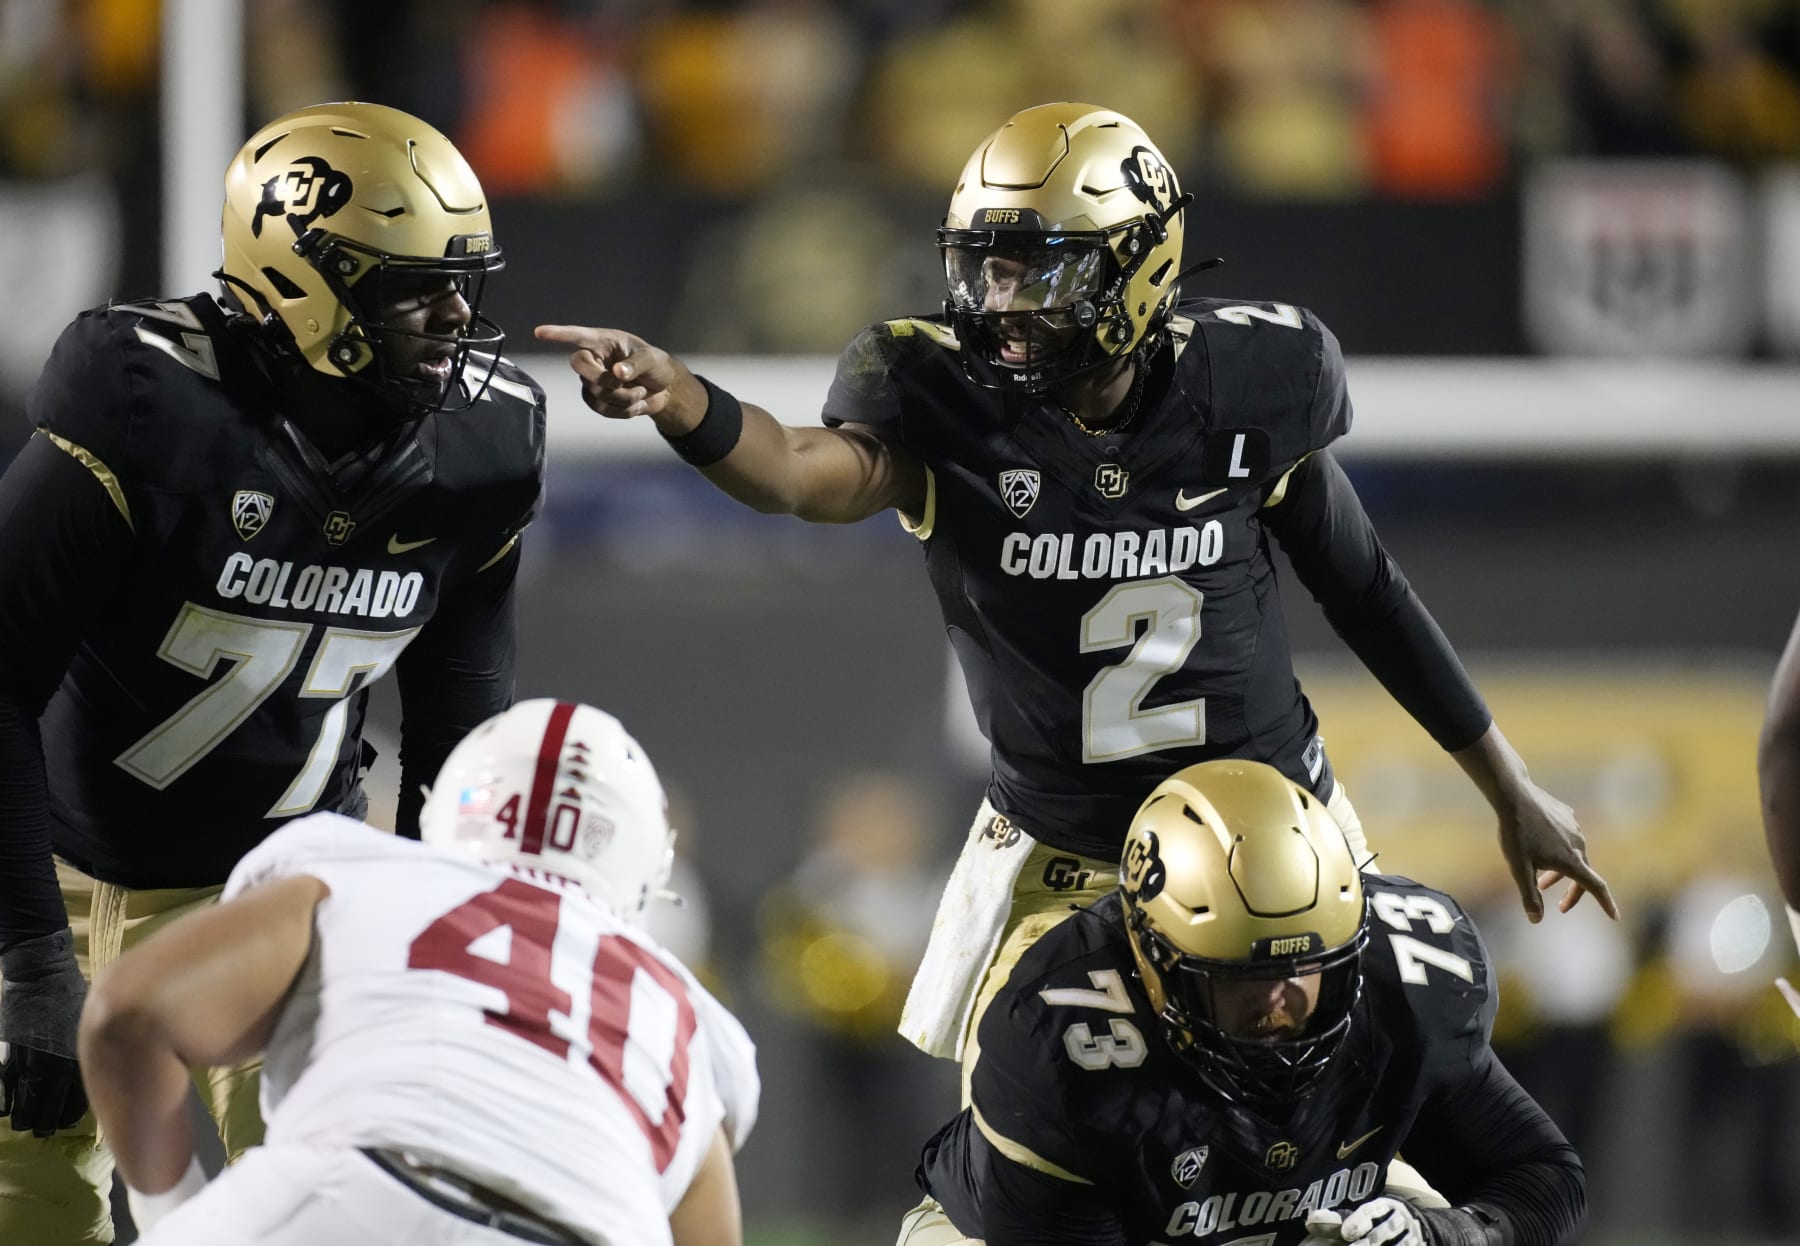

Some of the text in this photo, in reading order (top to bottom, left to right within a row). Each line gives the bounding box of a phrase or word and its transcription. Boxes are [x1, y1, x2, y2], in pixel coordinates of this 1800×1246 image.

[275, 163, 326, 216] CU
[984, 209, 1020, 223] BUFFS
[466, 236, 489, 253] BUFFS
[1213, 303, 1303, 330] 2
[1227, 433, 1250, 478] L
[1002, 471, 1038, 499] PAC
[1010, 490, 1030, 508] 12
[1095, 463, 1130, 499] CU
[234, 493, 272, 523] PAC
[239, 512, 260, 531] 12
[1000, 519, 1224, 580] COLORADO
[216, 551, 424, 618] COLORADO
[1079, 574, 1206, 765] 2
[112, 601, 425, 819] 77
[495, 793, 581, 853] 40
[1270, 935, 1310, 957] BUFFS
[1371, 891, 1474, 986] 73
[408, 877, 698, 1176] 40
[1038, 968, 1149, 1071] 73
[1179, 1164, 1197, 1181] 12
[1165, 1161, 1379, 1237] COLORADO
